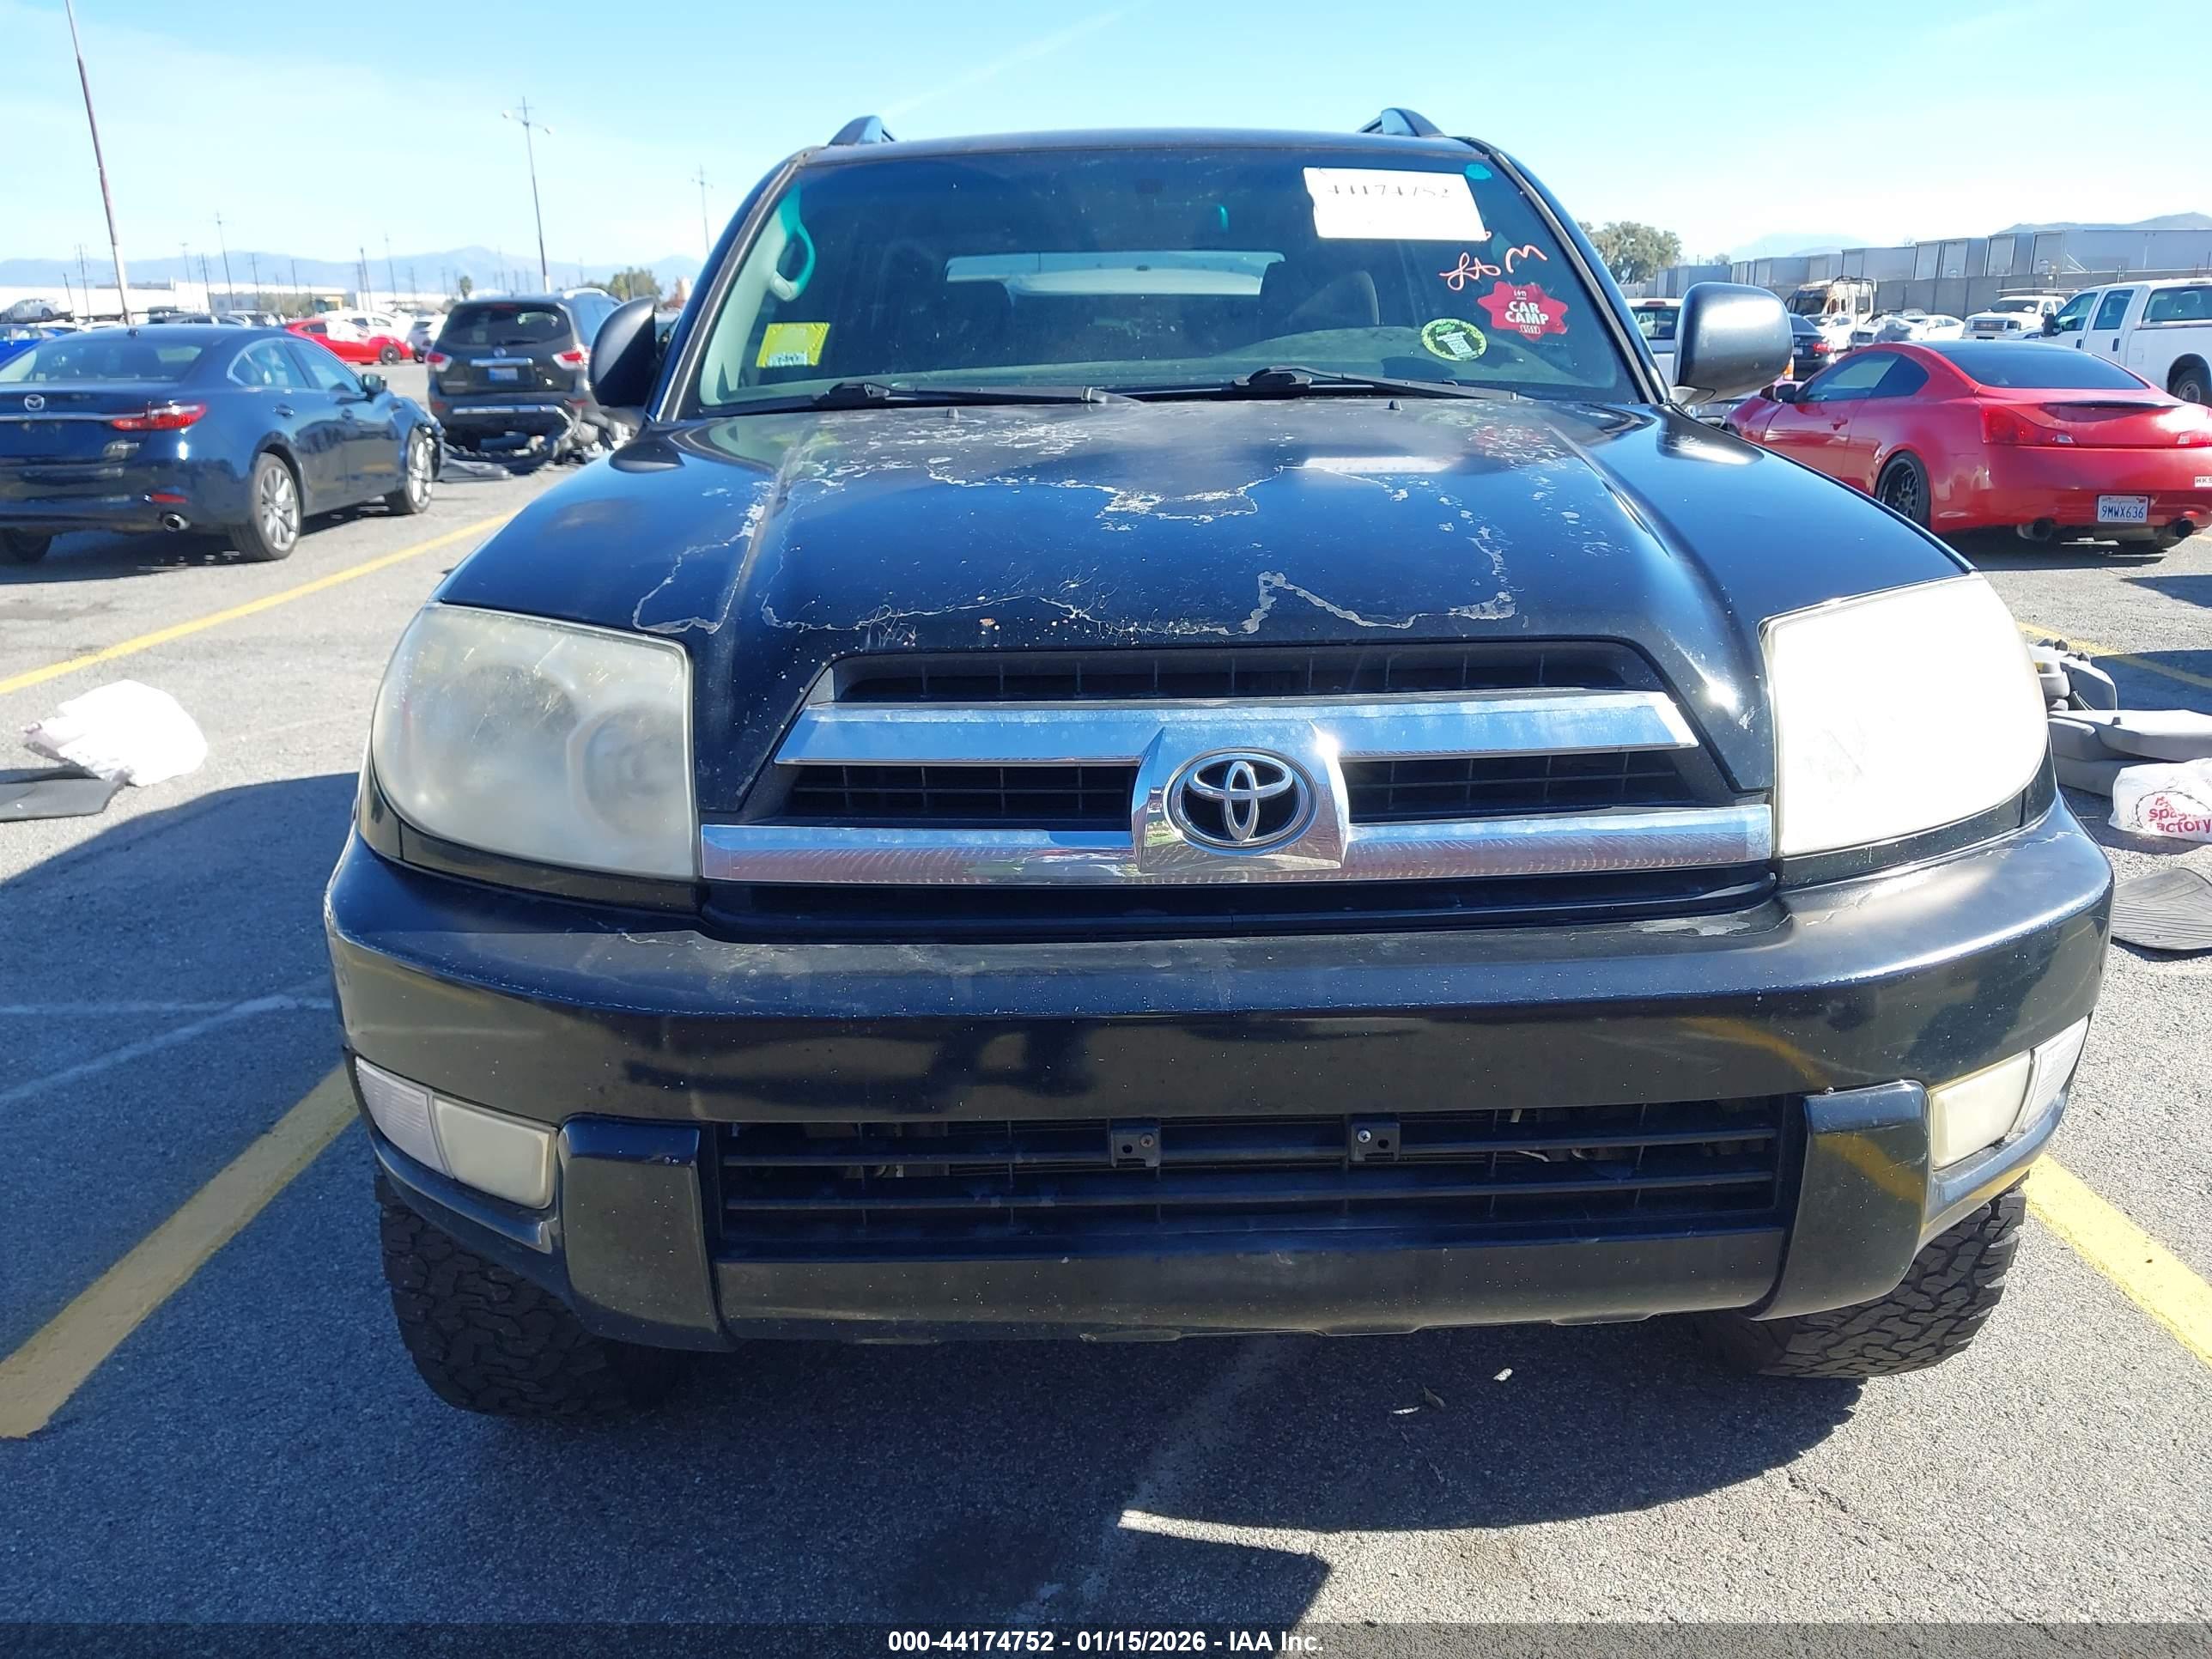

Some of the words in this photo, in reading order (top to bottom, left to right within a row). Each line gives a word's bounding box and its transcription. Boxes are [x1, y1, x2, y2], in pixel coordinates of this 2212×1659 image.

[1509, 301, 1540, 313] CAR
[1504, 311, 1549, 325] CAMP
[2101, 505, 2144, 519] 9MWX636
[2149, 818, 2211, 834] actory
